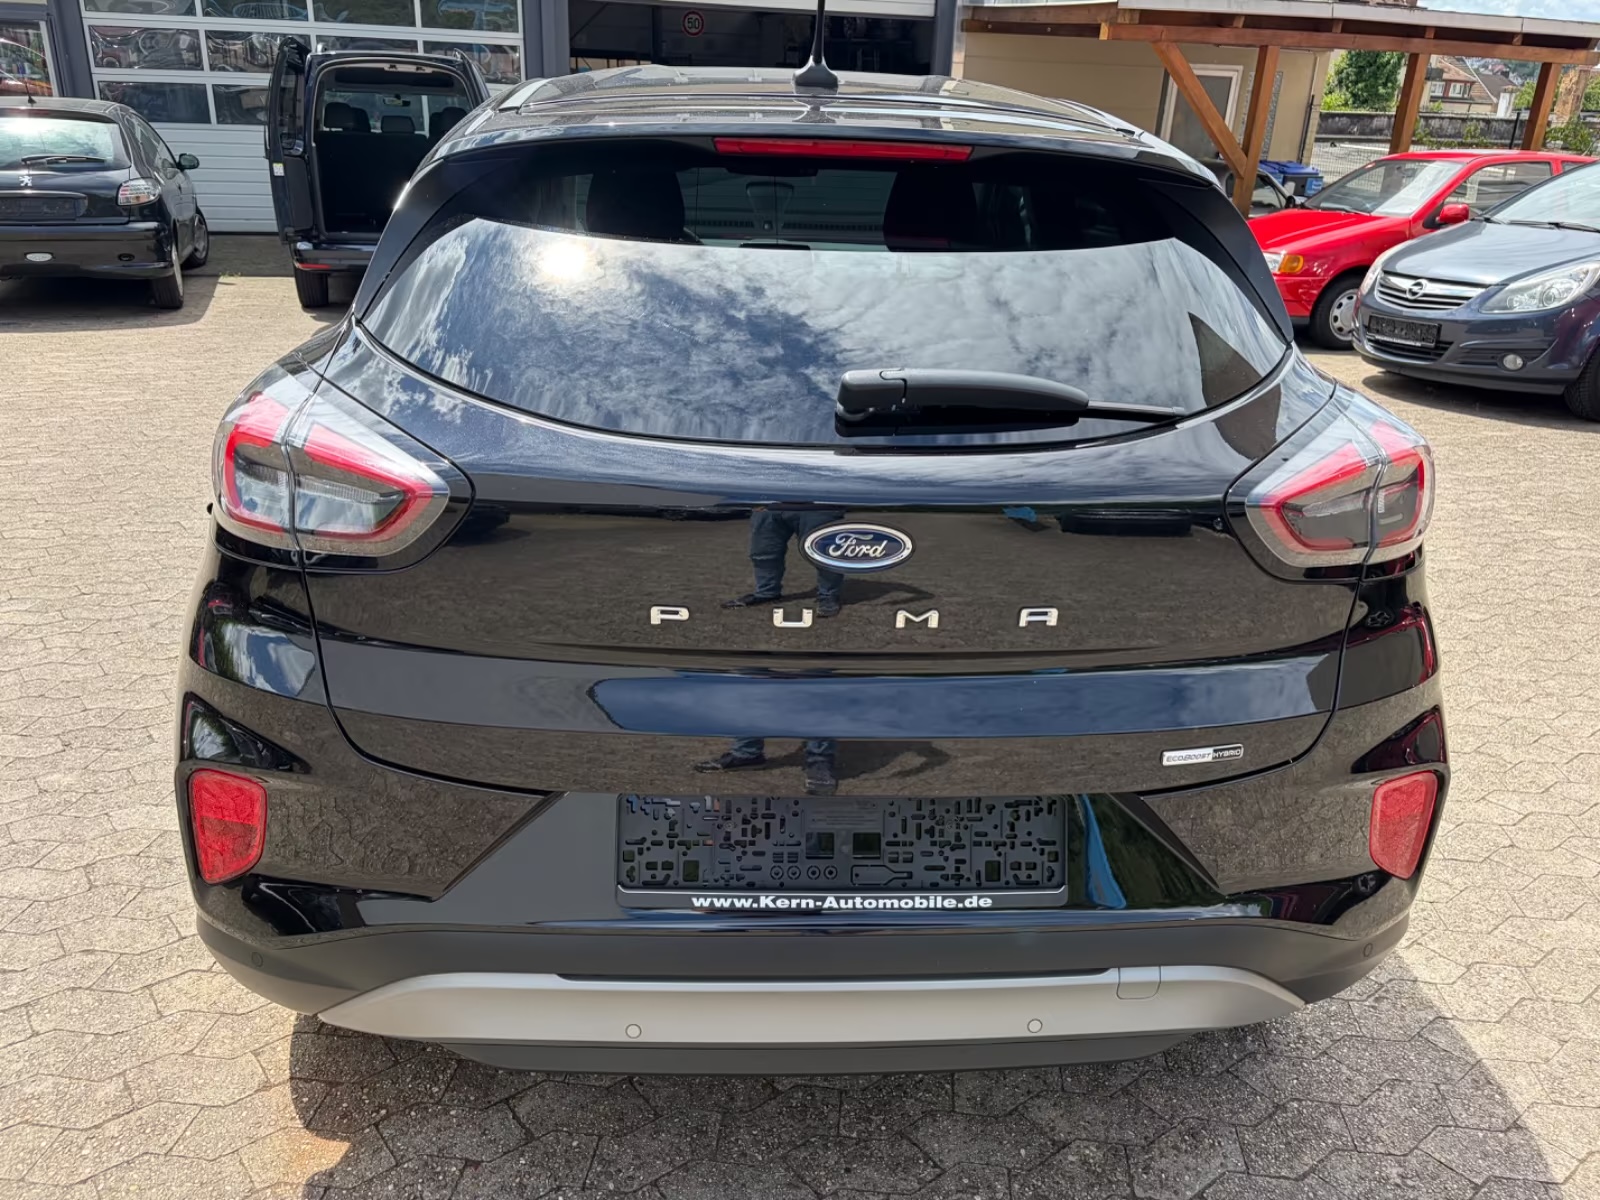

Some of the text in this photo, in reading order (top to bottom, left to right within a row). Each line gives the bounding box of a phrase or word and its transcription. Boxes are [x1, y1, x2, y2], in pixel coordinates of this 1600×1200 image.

[687, 17, 700, 30] 50
[828, 532, 888, 557] Ford
[1212, 748, 1241, 759] HYBRID
[691, 895, 993, 910] www.Kern-Automobile.de
